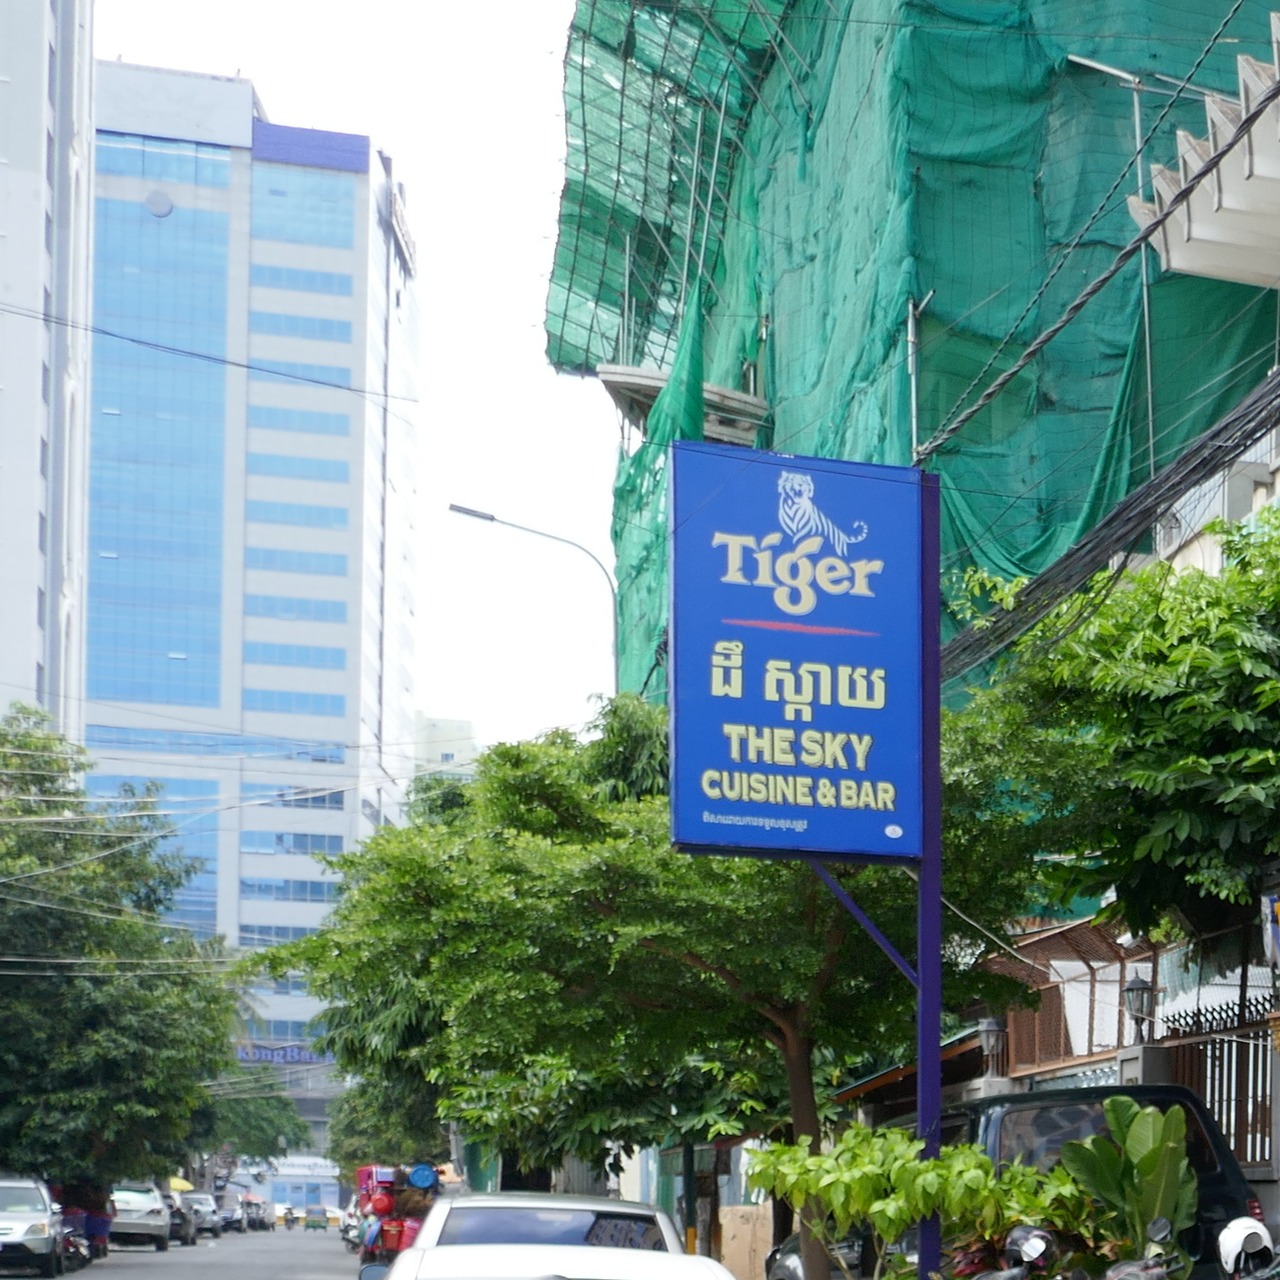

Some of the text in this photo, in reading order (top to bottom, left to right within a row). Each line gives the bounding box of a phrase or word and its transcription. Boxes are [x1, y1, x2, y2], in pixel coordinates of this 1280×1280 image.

[711, 531, 884, 616] Tiger
[723, 724, 873, 772] THE SKY
[702, 769, 896, 812] CUISINE & BAR
